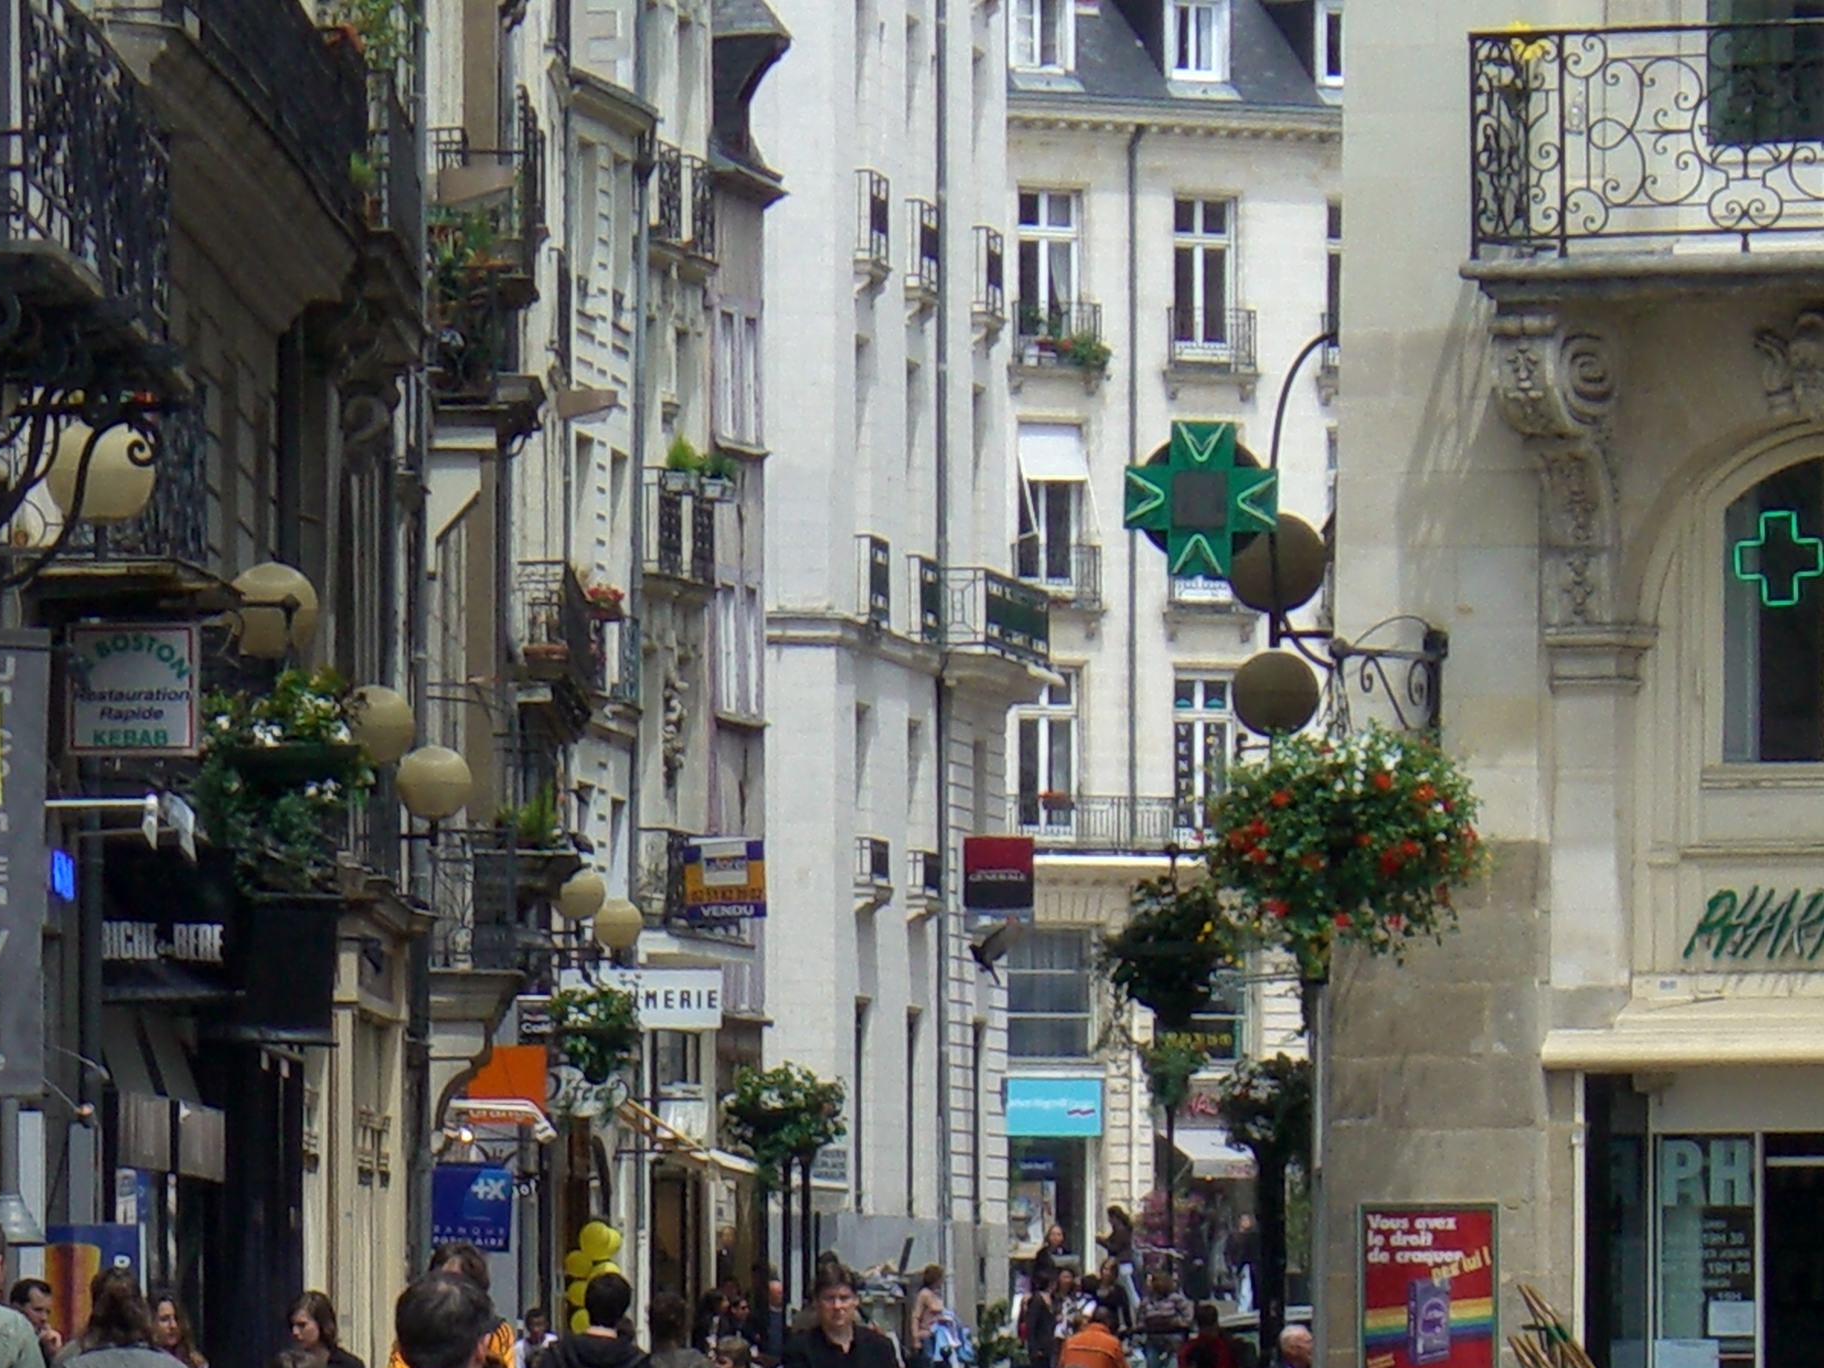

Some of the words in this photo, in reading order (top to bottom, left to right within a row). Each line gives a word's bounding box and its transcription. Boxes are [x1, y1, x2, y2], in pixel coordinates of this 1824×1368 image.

[99, 706, 164, 723] Rapide
[93, 729, 168, 746] KEBAB
[700, 904, 755, 917] VENDU
[644, 990, 719, 1010] MERIE
[1367, 1215, 1409, 1229] Vous
[1368, 1231, 1385, 1246] le
[1390, 1231, 1433, 1246] droit
[1368, 1248, 1390, 1263] de
[1396, 1251, 1465, 1266] craquer
